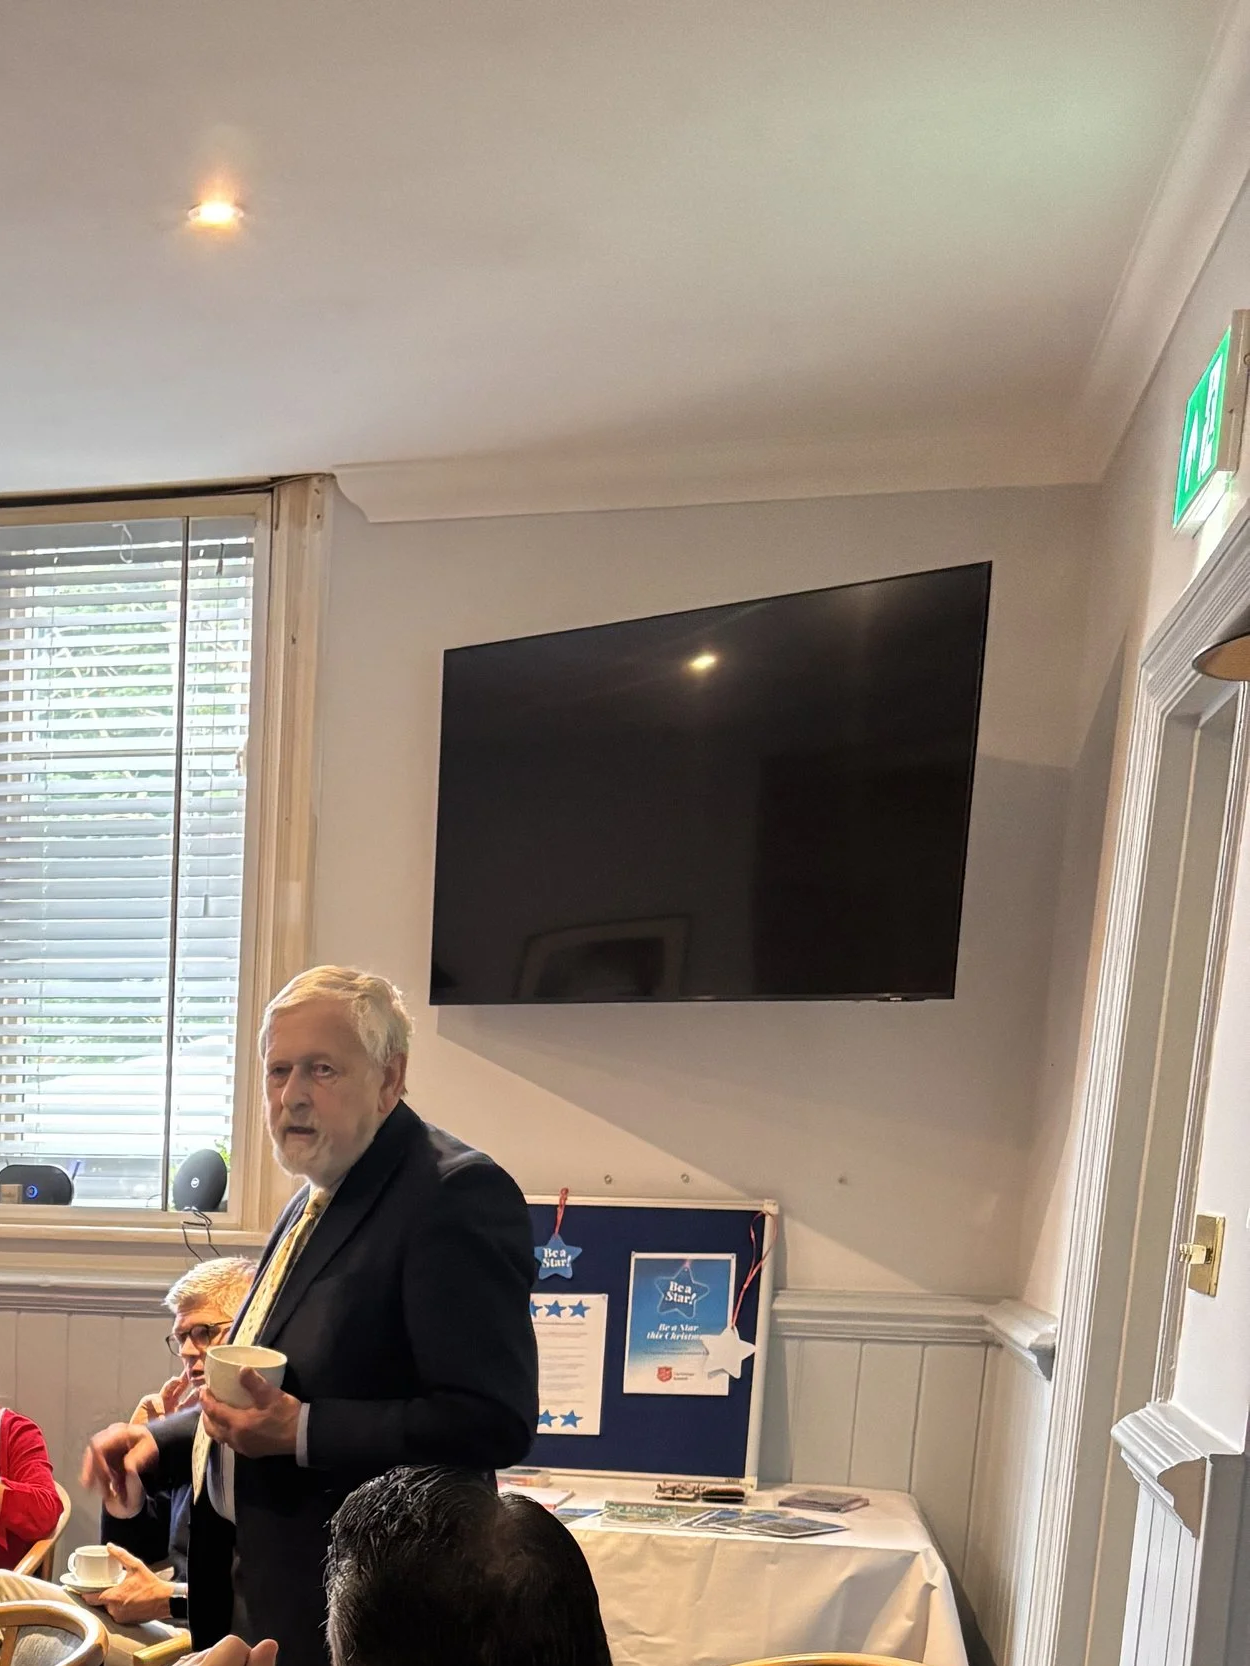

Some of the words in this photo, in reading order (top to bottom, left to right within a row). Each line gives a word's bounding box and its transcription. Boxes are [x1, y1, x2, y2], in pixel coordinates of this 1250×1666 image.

[543, 1247, 558, 1258] Be
[560, 1249, 566, 1258] a
[541, 1255, 572, 1268] Star!
[669, 1281, 684, 1293] Be
[685, 1285, 692, 1294] a
[665, 1291, 697, 1305] Star!
